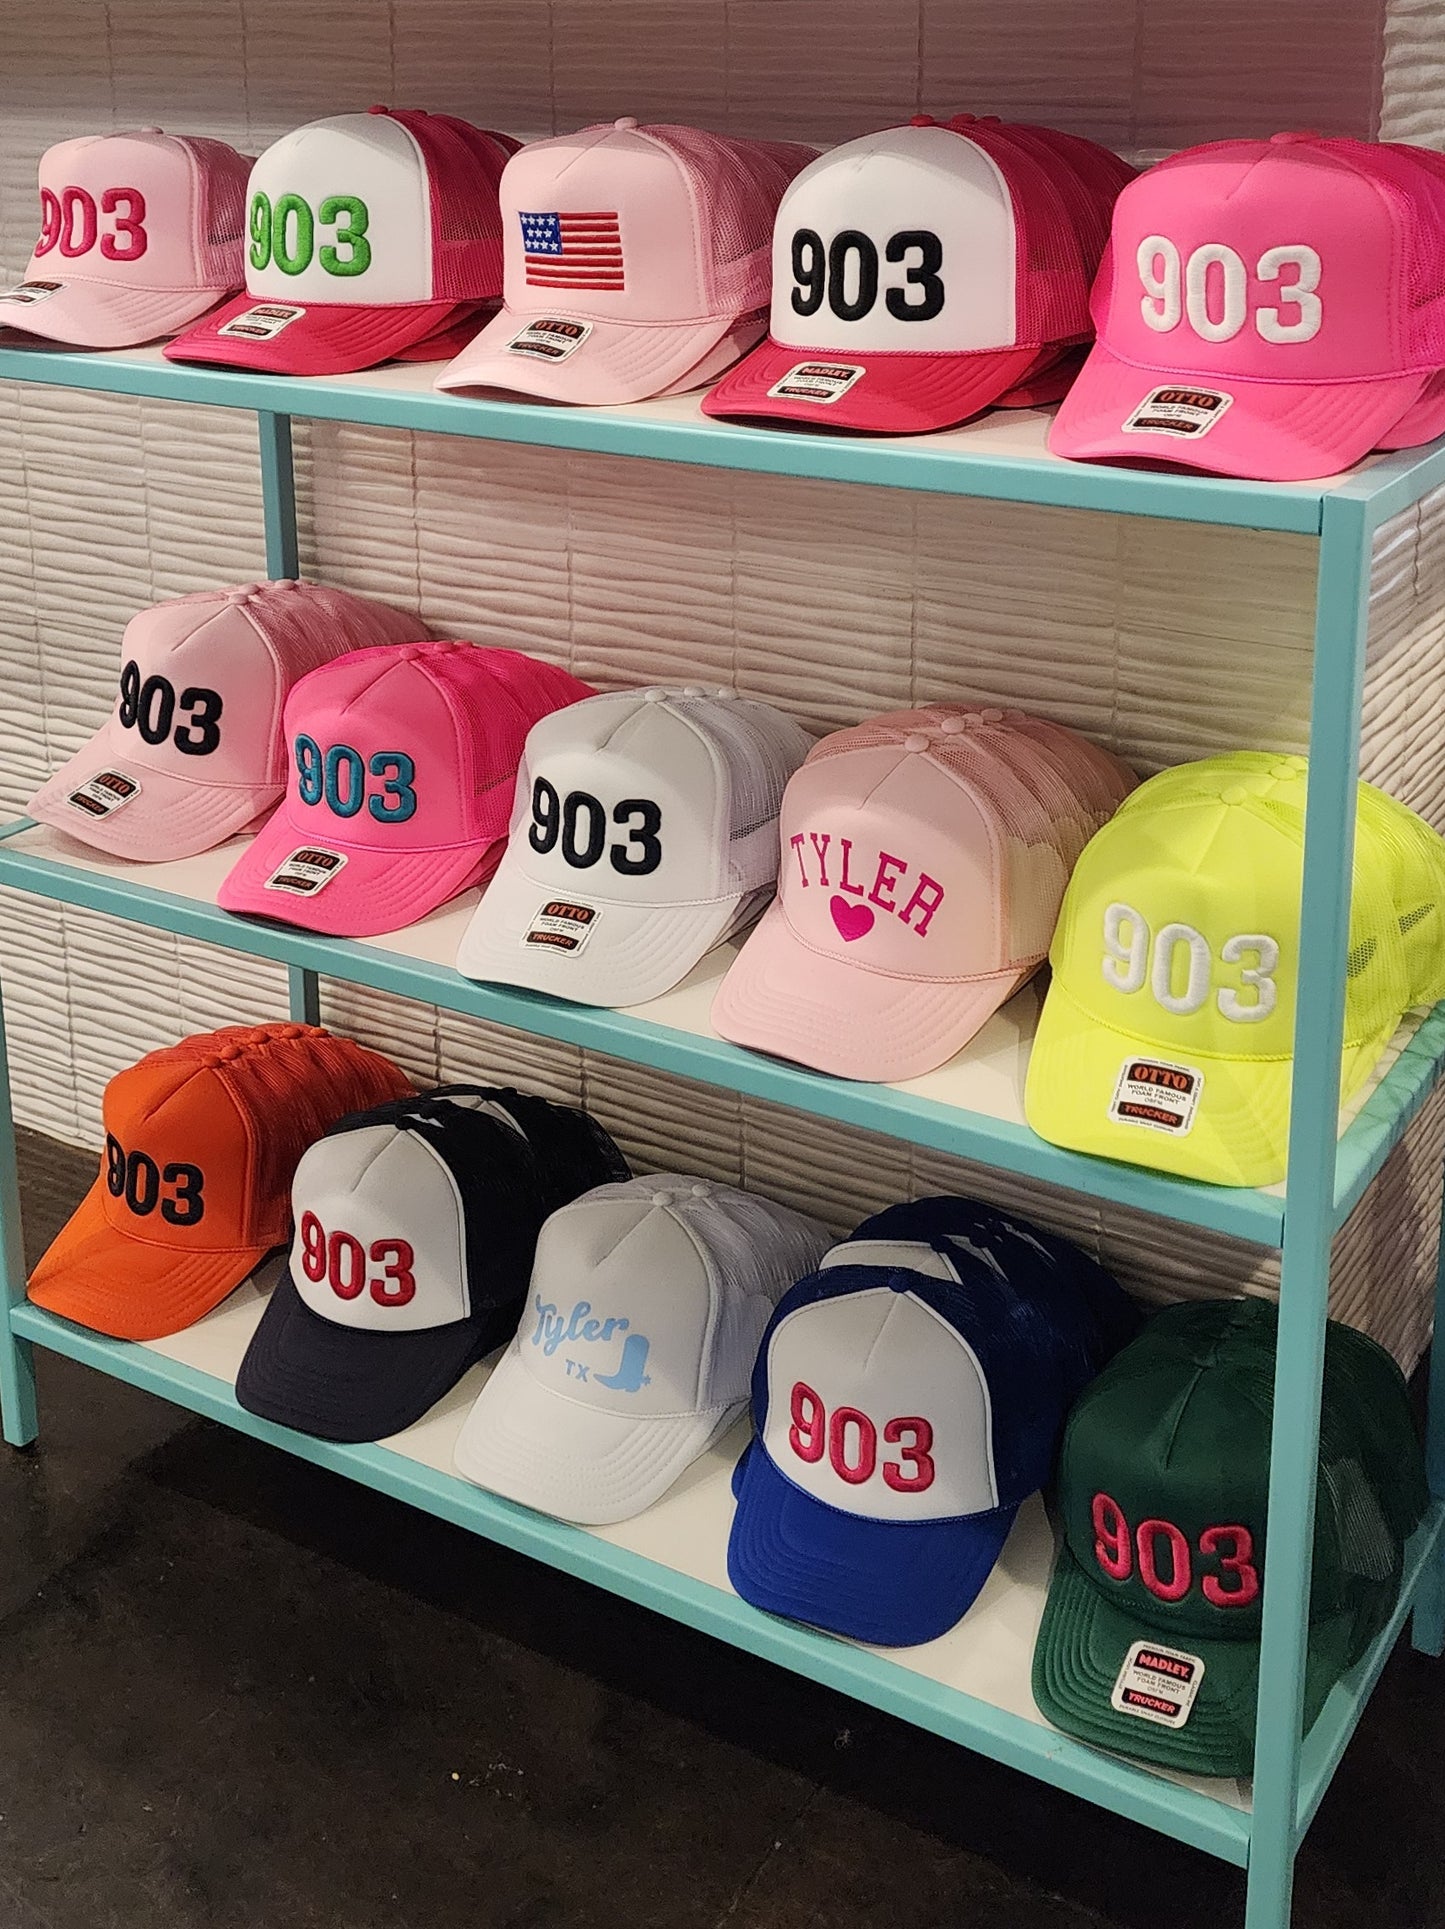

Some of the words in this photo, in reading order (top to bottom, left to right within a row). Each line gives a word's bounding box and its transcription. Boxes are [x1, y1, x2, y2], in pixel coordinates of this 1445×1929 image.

[35, 186, 147, 261] 903
[250, 191, 371, 277] 903
[791, 228, 945, 322] 903
[1136, 235, 1323, 345] 903
[535, 321, 578, 336] OTTO
[517, 342, 559, 355] TRUCKER
[784, 387, 830, 397] TRUCKER
[1160, 391, 1214, 408] OTTO
[1140, 419, 1194, 430] TRUCKER
[119, 659, 223, 755] 903
[99, 775, 130, 794] OTTO
[295, 733, 416, 823] 903
[528, 775, 662, 876] 903
[297, 851, 334, 867] OTTO
[278, 876, 313, 888] TRUCKER
[790, 832, 945, 938] TYLER
[547, 903, 589, 921] OTTO
[532, 933, 573, 946] TRUCKER
[1103, 902, 1280, 1022] 903
[1134, 1066, 1188, 1089] OTTO
[1127, 1083, 1154, 1092] WORLD
[1155, 1088, 1187, 1102] FAMOUS
[1131, 1089, 1152, 1097] FOAM
[1154, 1092, 1180, 1105] FRONT
[1124, 1104, 1178, 1125] TRUCKER
[106, 1133, 205, 1226] 903
[300, 1210, 416, 1306] 903
[532, 1294, 630, 1356] Tyler
[565, 1359, 590, 1383] TX
[789, 1381, 935, 1492] 903
[1092, 1492, 1259, 1607] 903
[1132, 1669, 1157, 1681] WORLD
[1158, 1676, 1186, 1690] FAMOUS
[1136, 1676, 1156, 1686] FOAM
[1157, 1681, 1181, 1694] FRONT
[1128, 1691, 1176, 1714] TRUCKER
